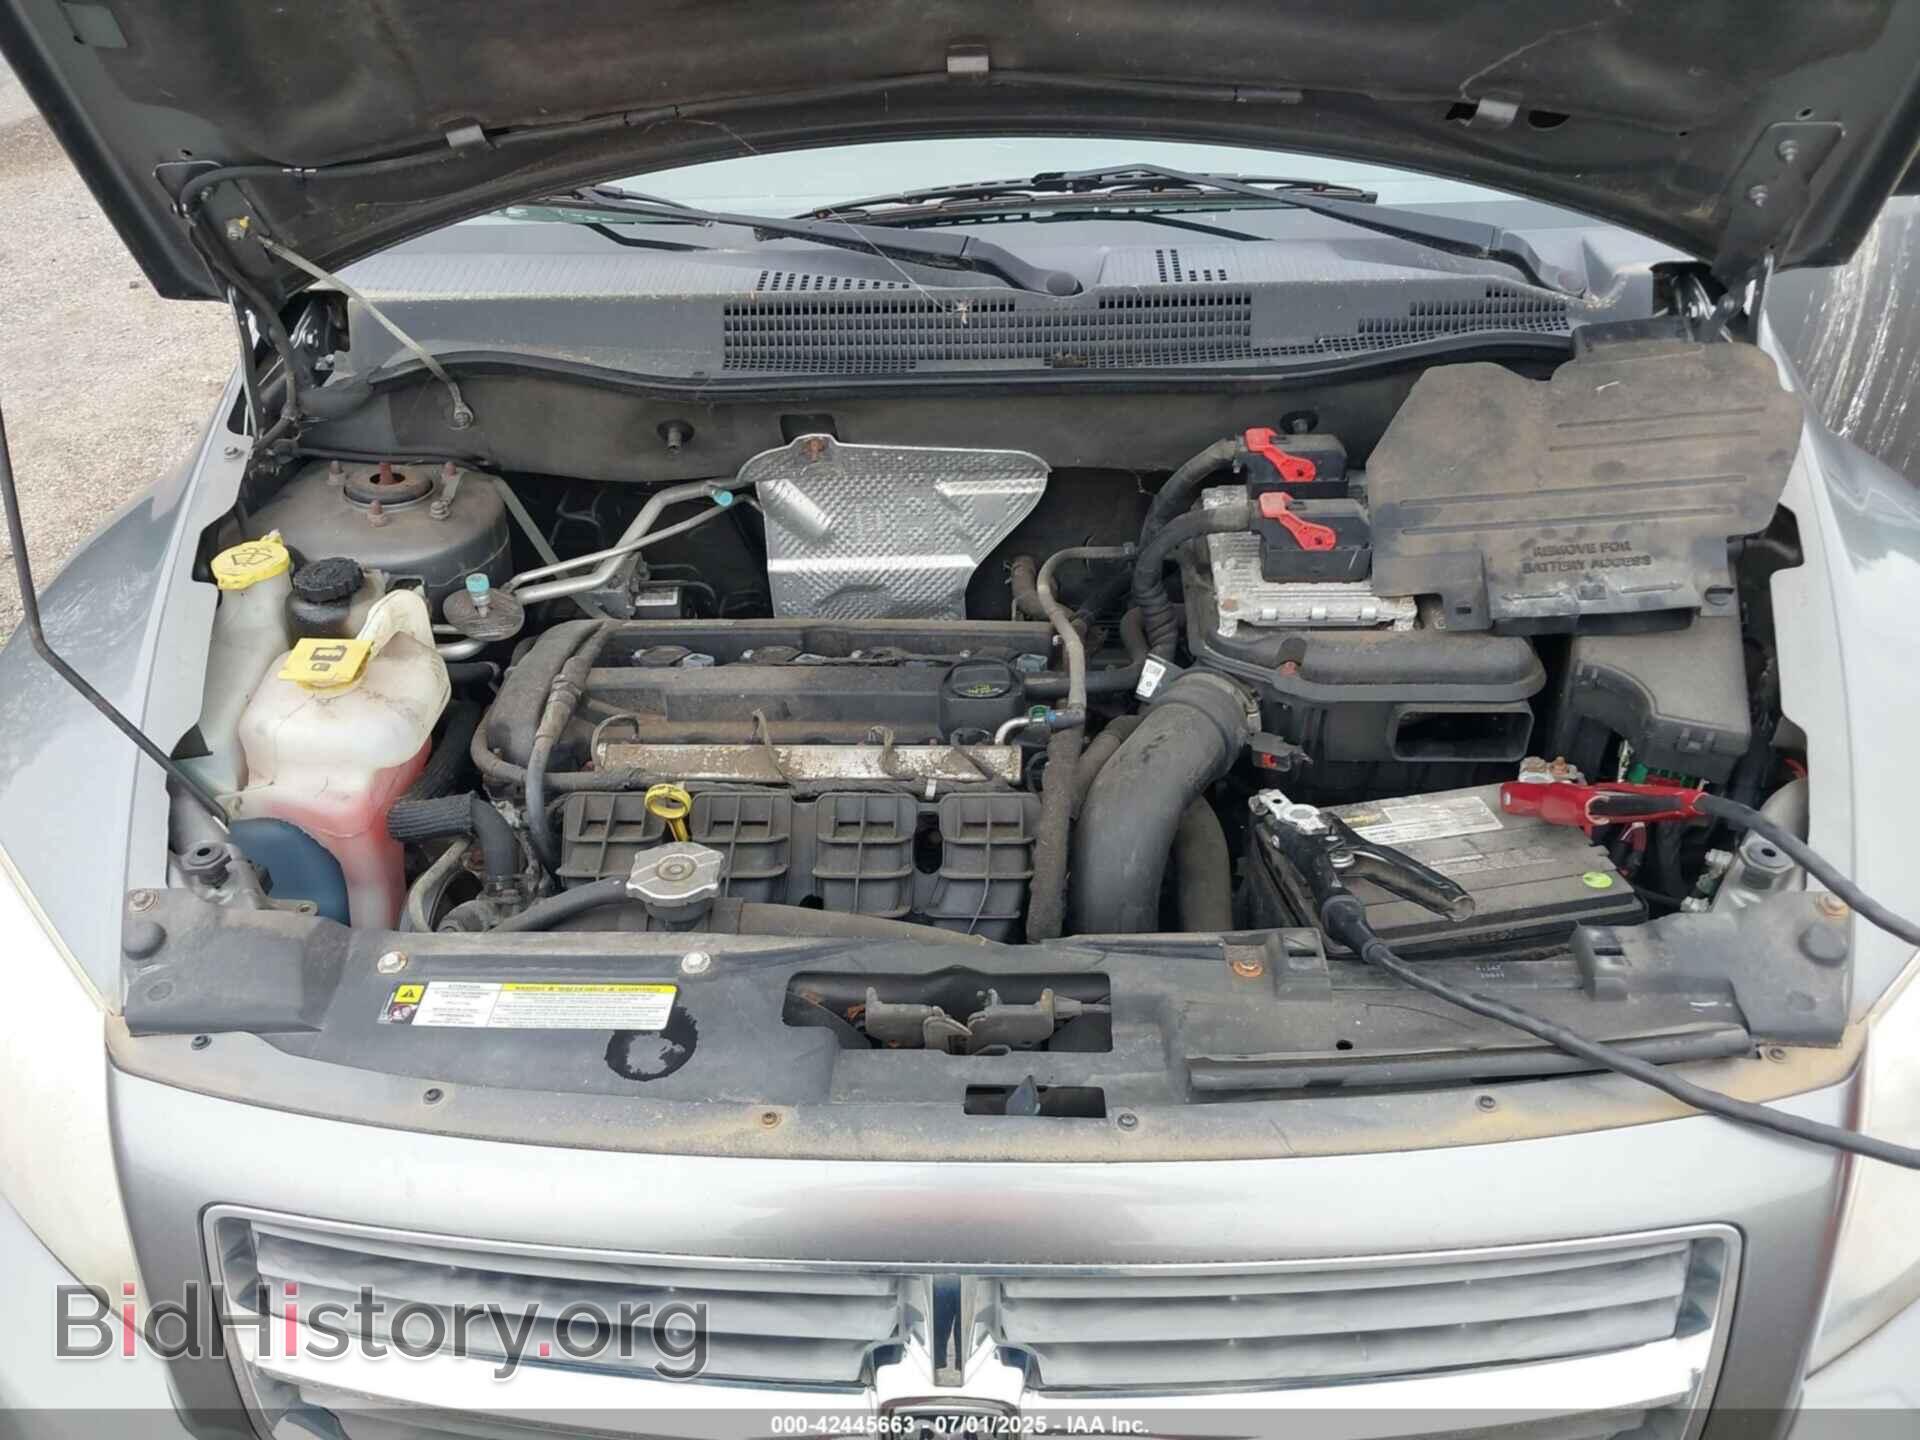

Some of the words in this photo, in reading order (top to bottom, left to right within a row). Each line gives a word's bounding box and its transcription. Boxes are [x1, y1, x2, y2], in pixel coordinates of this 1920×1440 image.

[1533, 543, 1597, 558] REMOVE
[1599, 541, 1633, 553] FOR
[1521, 559, 1586, 575] BATTERY
[1590, 554, 1652, 570] ACCESS
